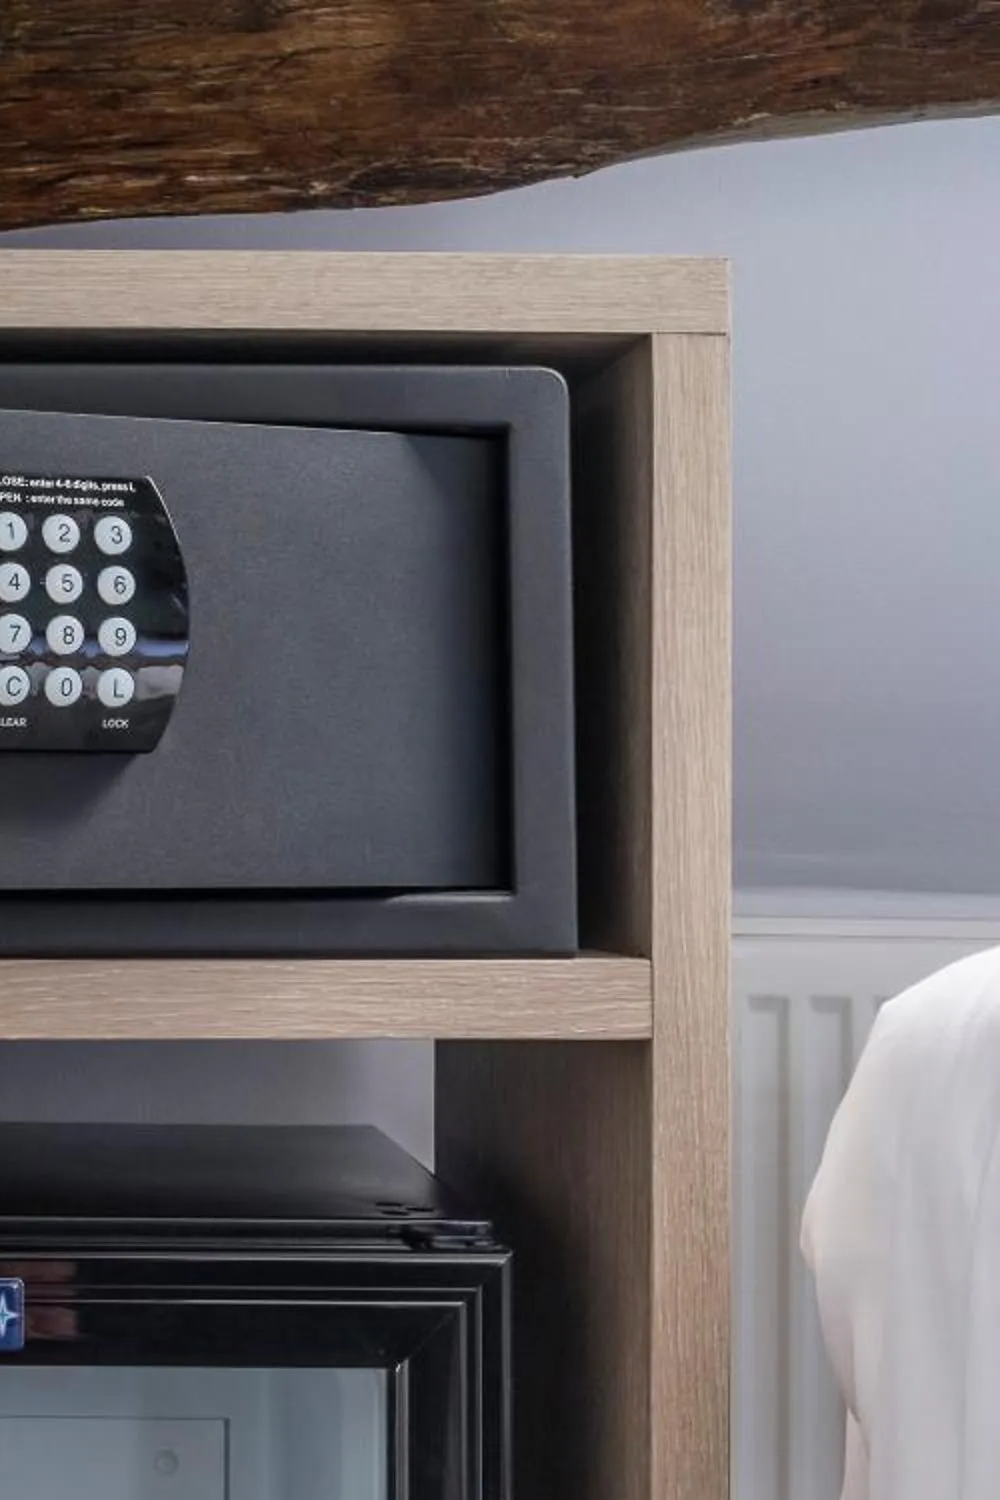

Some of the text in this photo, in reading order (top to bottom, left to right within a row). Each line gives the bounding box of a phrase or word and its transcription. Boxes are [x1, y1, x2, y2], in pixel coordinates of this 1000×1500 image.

[56, 494, 72, 506] the
[73, 496, 100, 507] same
[101, 497, 125, 508] code
[5, 522, 16, 540] 1
[58, 524, 72, 543] 2
[110, 525, 123, 544] 3
[8, 573, 21, 590] 4
[61, 574, 74, 592] 5
[114, 576, 127, 594] 6
[9, 624, 22, 643] 7
[62, 626, 76, 645] 8
[114, 628, 128, 647] 9
[5, 676, 23, 698] C
[112, 679, 124, 699] L
[102, 719, 130, 729] LOCK
